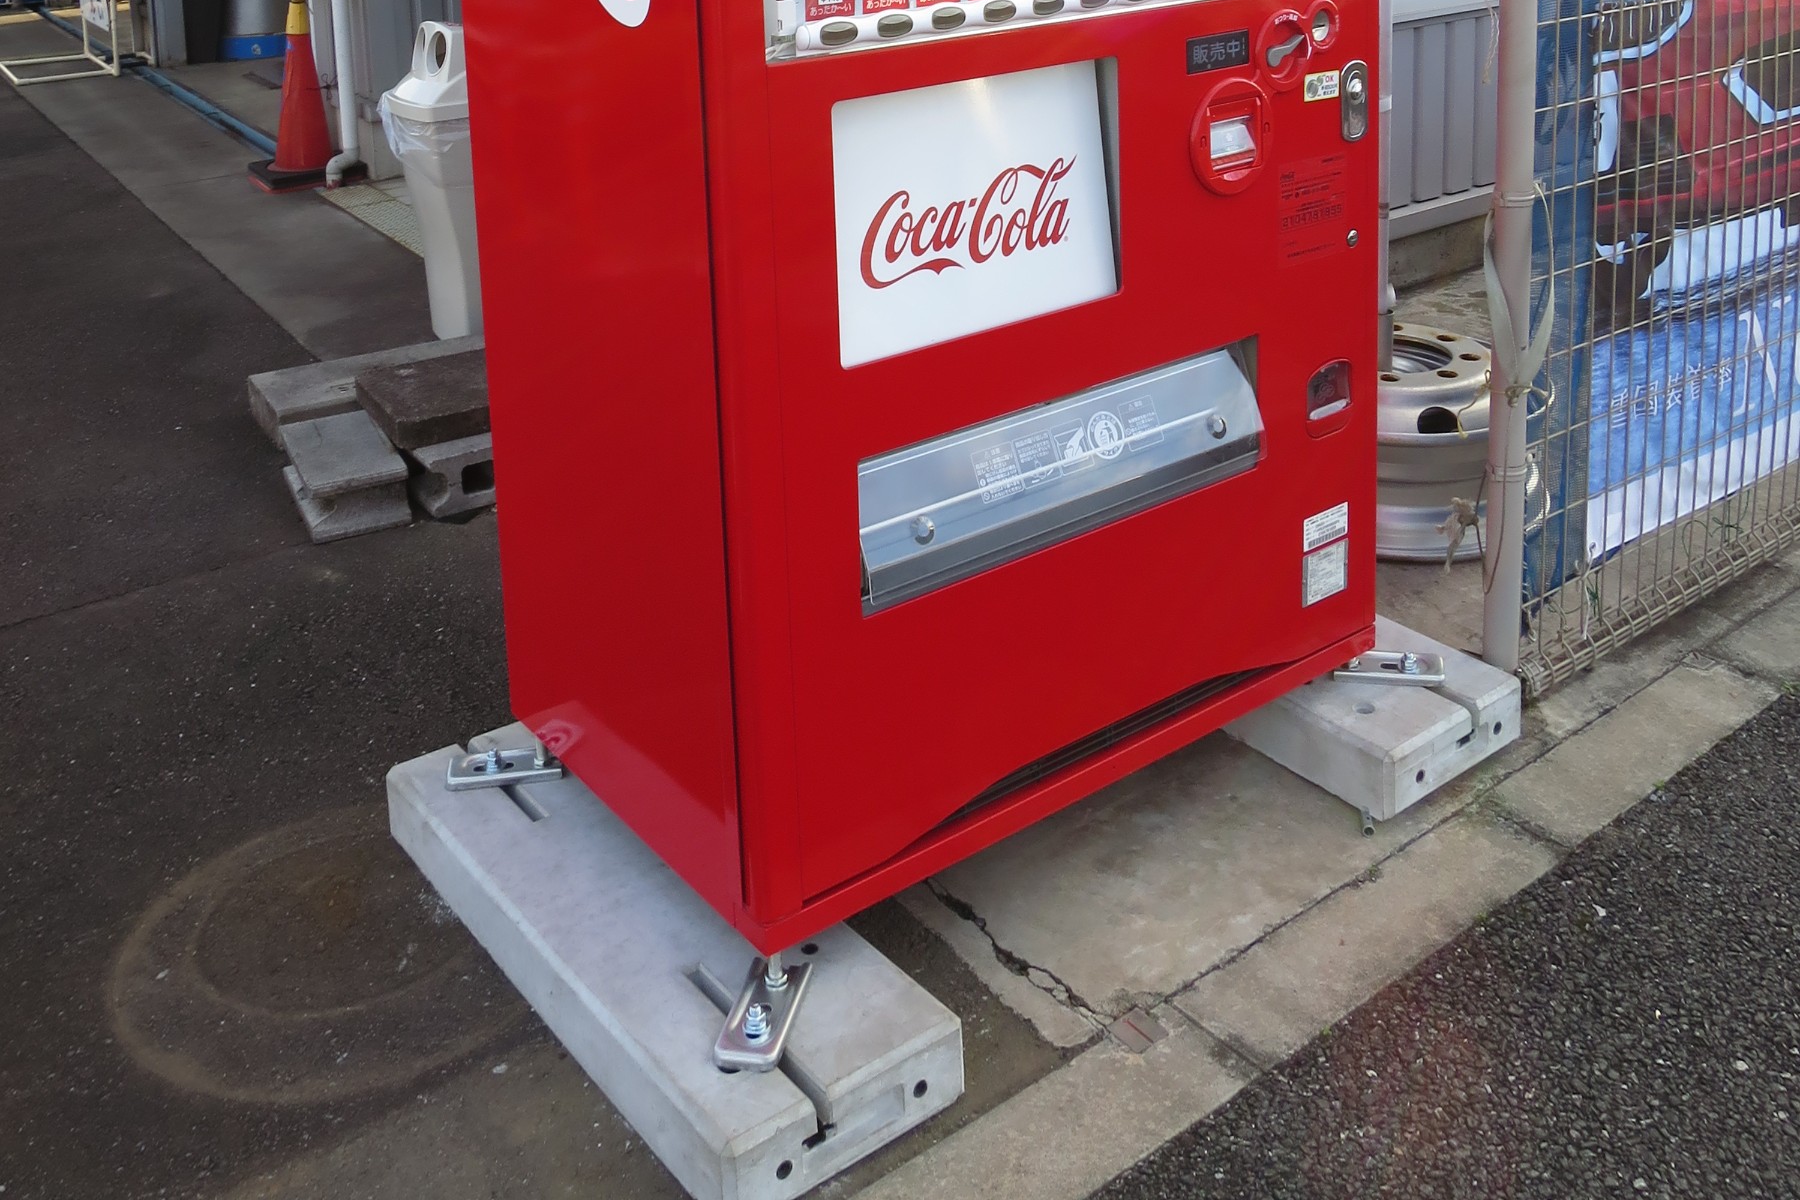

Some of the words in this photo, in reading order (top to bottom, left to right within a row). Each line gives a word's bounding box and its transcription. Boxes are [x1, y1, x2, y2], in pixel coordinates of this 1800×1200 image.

[809, 4, 852, 16] あったか〜い
[1191, 39, 1241, 65] 販売中
[1325, 74, 1335, 83] OK
[860, 153, 1078, 289] Coca-Cola
[1610, 356, 1734, 430] 雪国装着率
